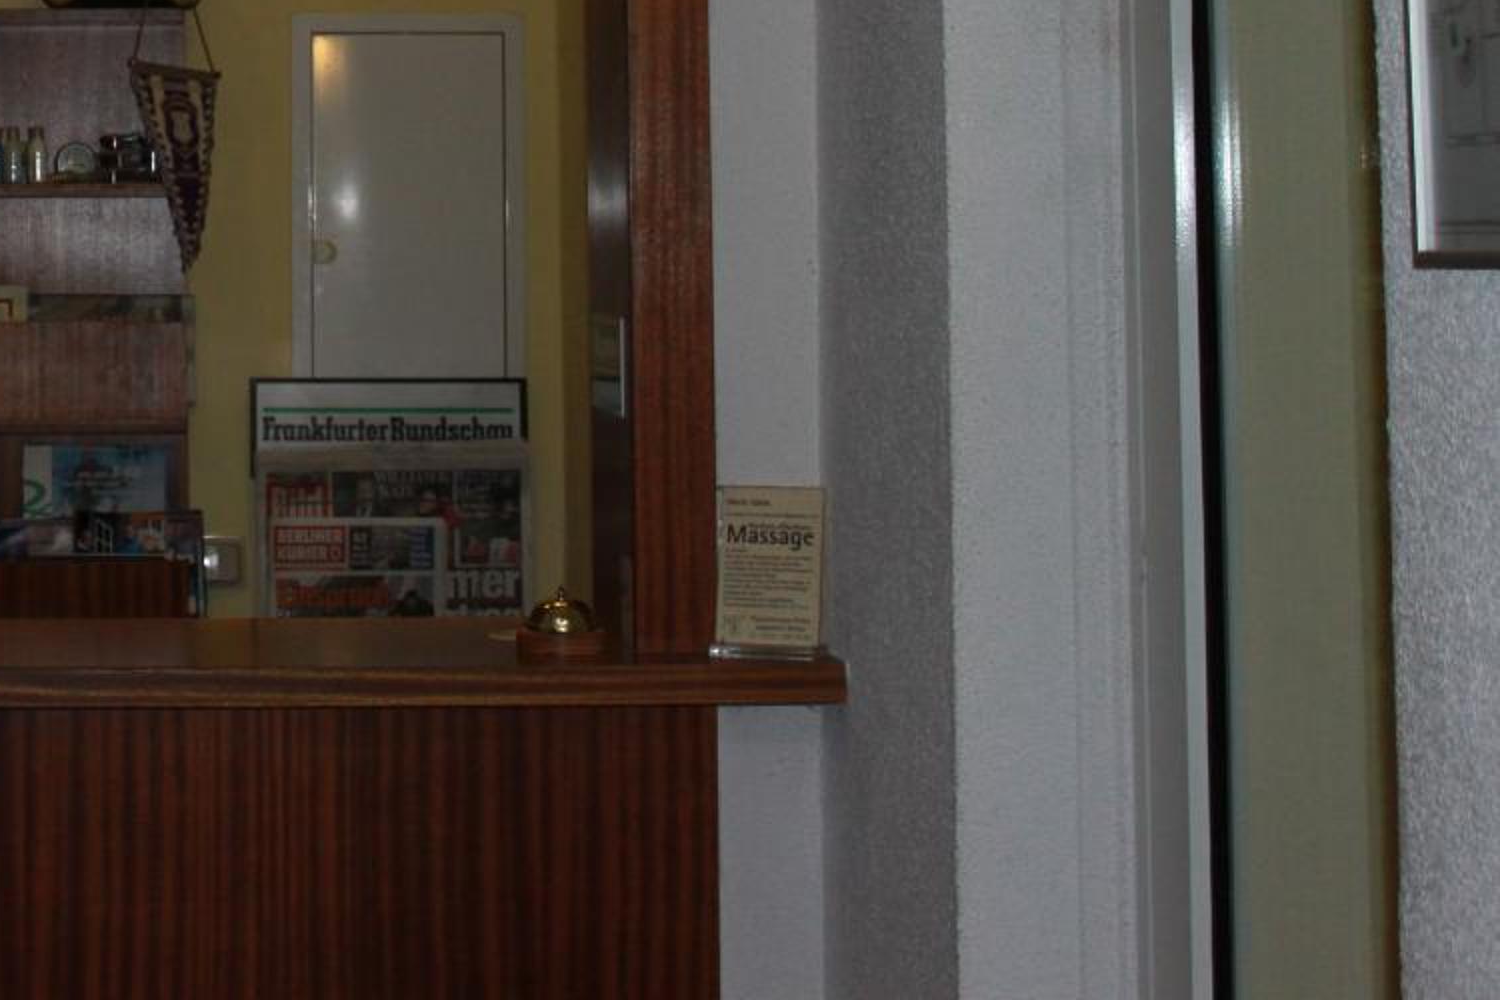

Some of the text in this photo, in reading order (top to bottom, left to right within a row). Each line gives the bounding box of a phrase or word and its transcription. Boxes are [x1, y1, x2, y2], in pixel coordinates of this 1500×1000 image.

[262, 415, 514, 442] Frankfurter Rundschau
[726, 523, 816, 552] Massage
